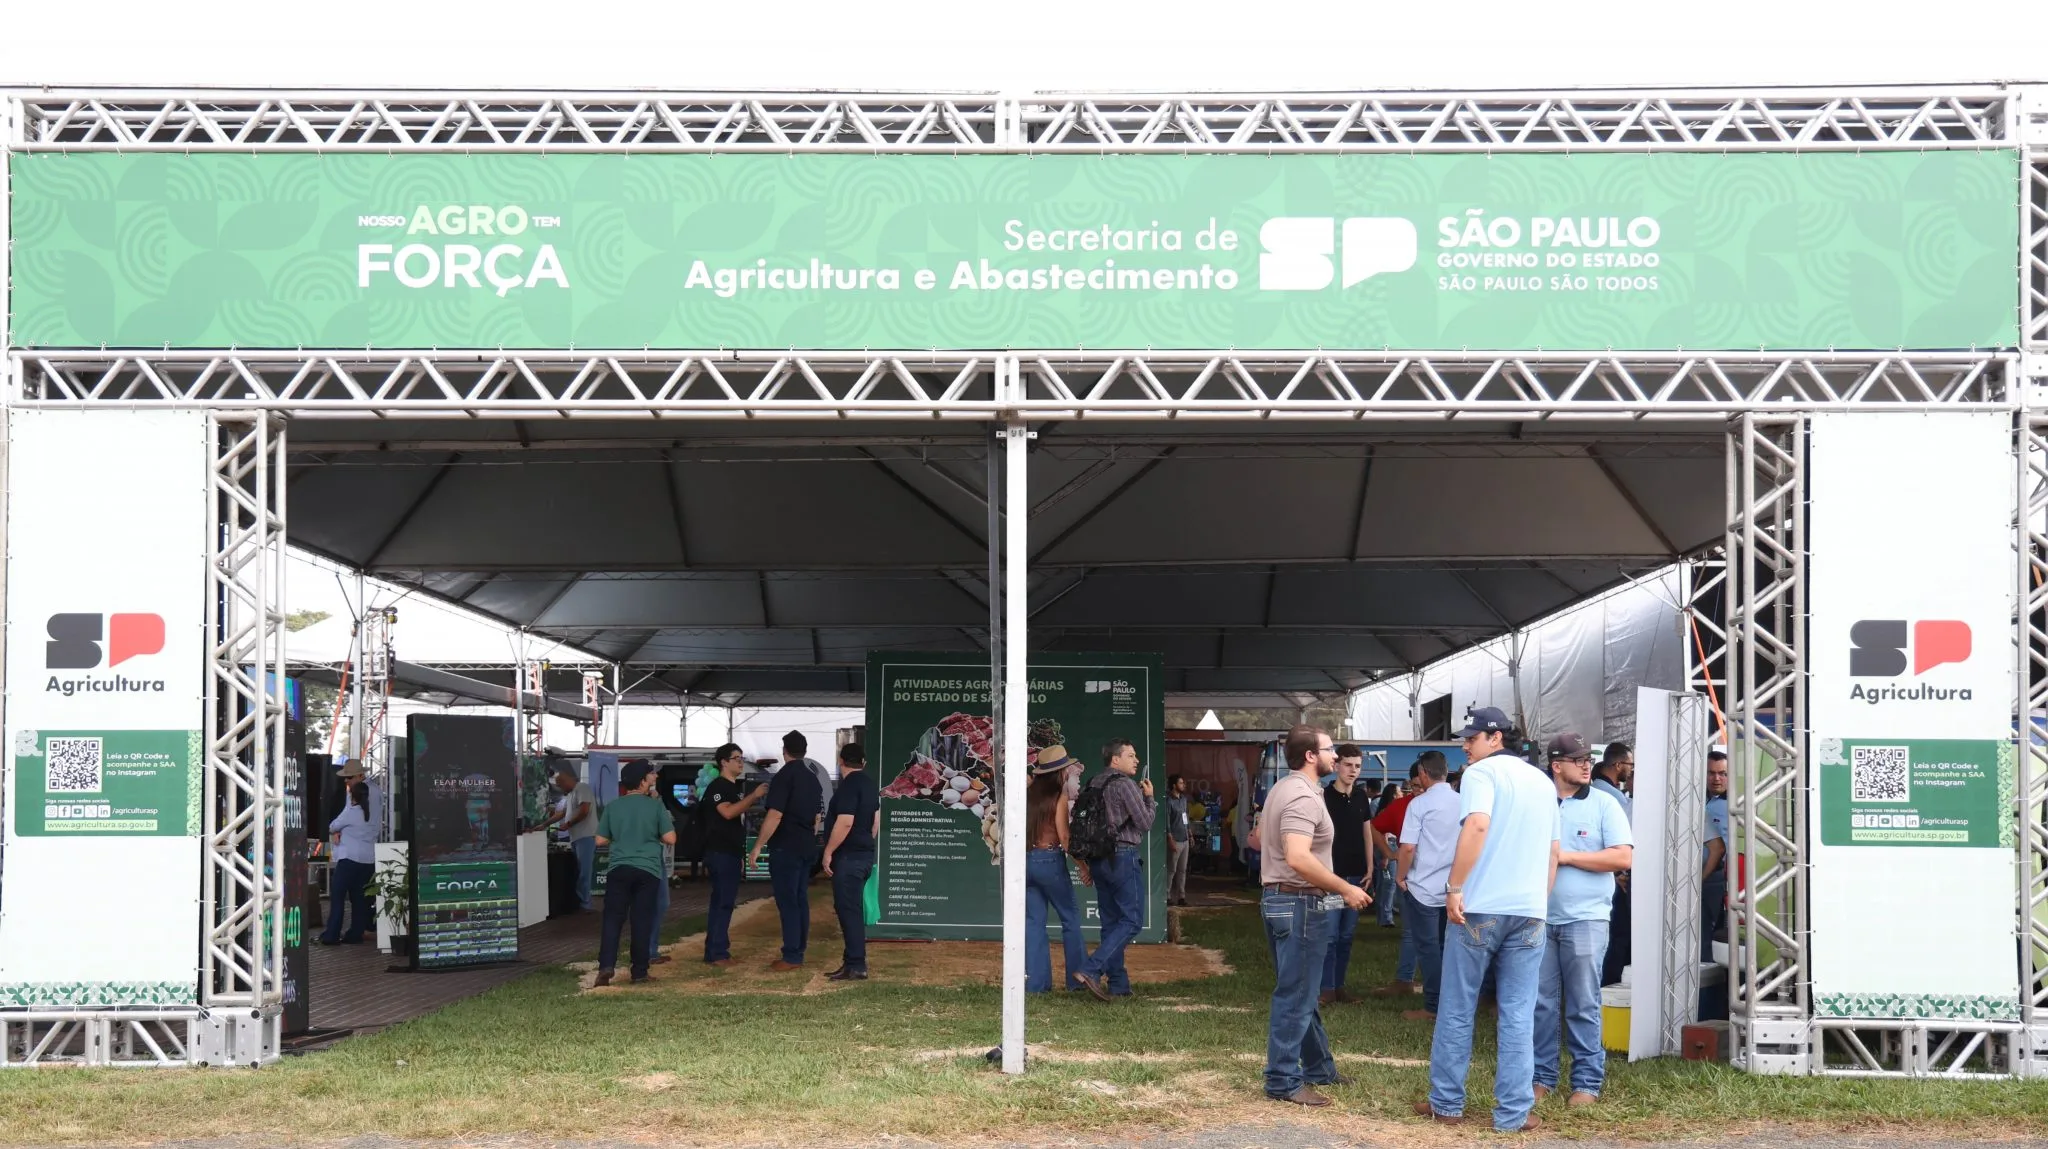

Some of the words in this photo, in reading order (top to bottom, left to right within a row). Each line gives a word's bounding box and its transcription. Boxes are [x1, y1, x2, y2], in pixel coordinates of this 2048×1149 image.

[358, 216, 406, 226] NOSSO
[407, 205, 528, 235] AGRO
[532, 216, 560, 227] TEM
[1437, 208, 1521, 248] SÃO
[1531, 216, 1661, 248] PAULO
[1003, 219, 1182, 251] Secretaria
[1195, 217, 1238, 250] de
[1437, 252, 1538, 268] GOVERNO
[1546, 252, 1576, 268] DO
[1582, 252, 1660, 268] ESTADO
[358, 244, 570, 298] FORÇA
[684, 258, 900, 298] Agricultura
[914, 268, 936, 290] e
[949, 258, 1238, 290] Abastecimento
[1438, 273, 1476, 291] SÃO
[1484, 276, 1542, 291] PAULO
[1550, 273, 1588, 291] SÃO
[1596, 276, 1658, 291] TODOS
[45, 674, 165, 696] Agricultura
[893, 679, 963, 689] ATIVIDADES
[893, 692, 911, 702] DO
[914, 692, 960, 702] ESTADO
[962, 693, 978, 703] DE
[1850, 682, 1972, 705] Agricultura
[112, 807, 158, 815] /agriculturasp
[47, 821, 155, 829] www.agricultura.sp.gov.br
[1921, 817, 1969, 825] /agriculturasp
[1854, 832, 1966, 840] www.agricultura.sp.gov.br
